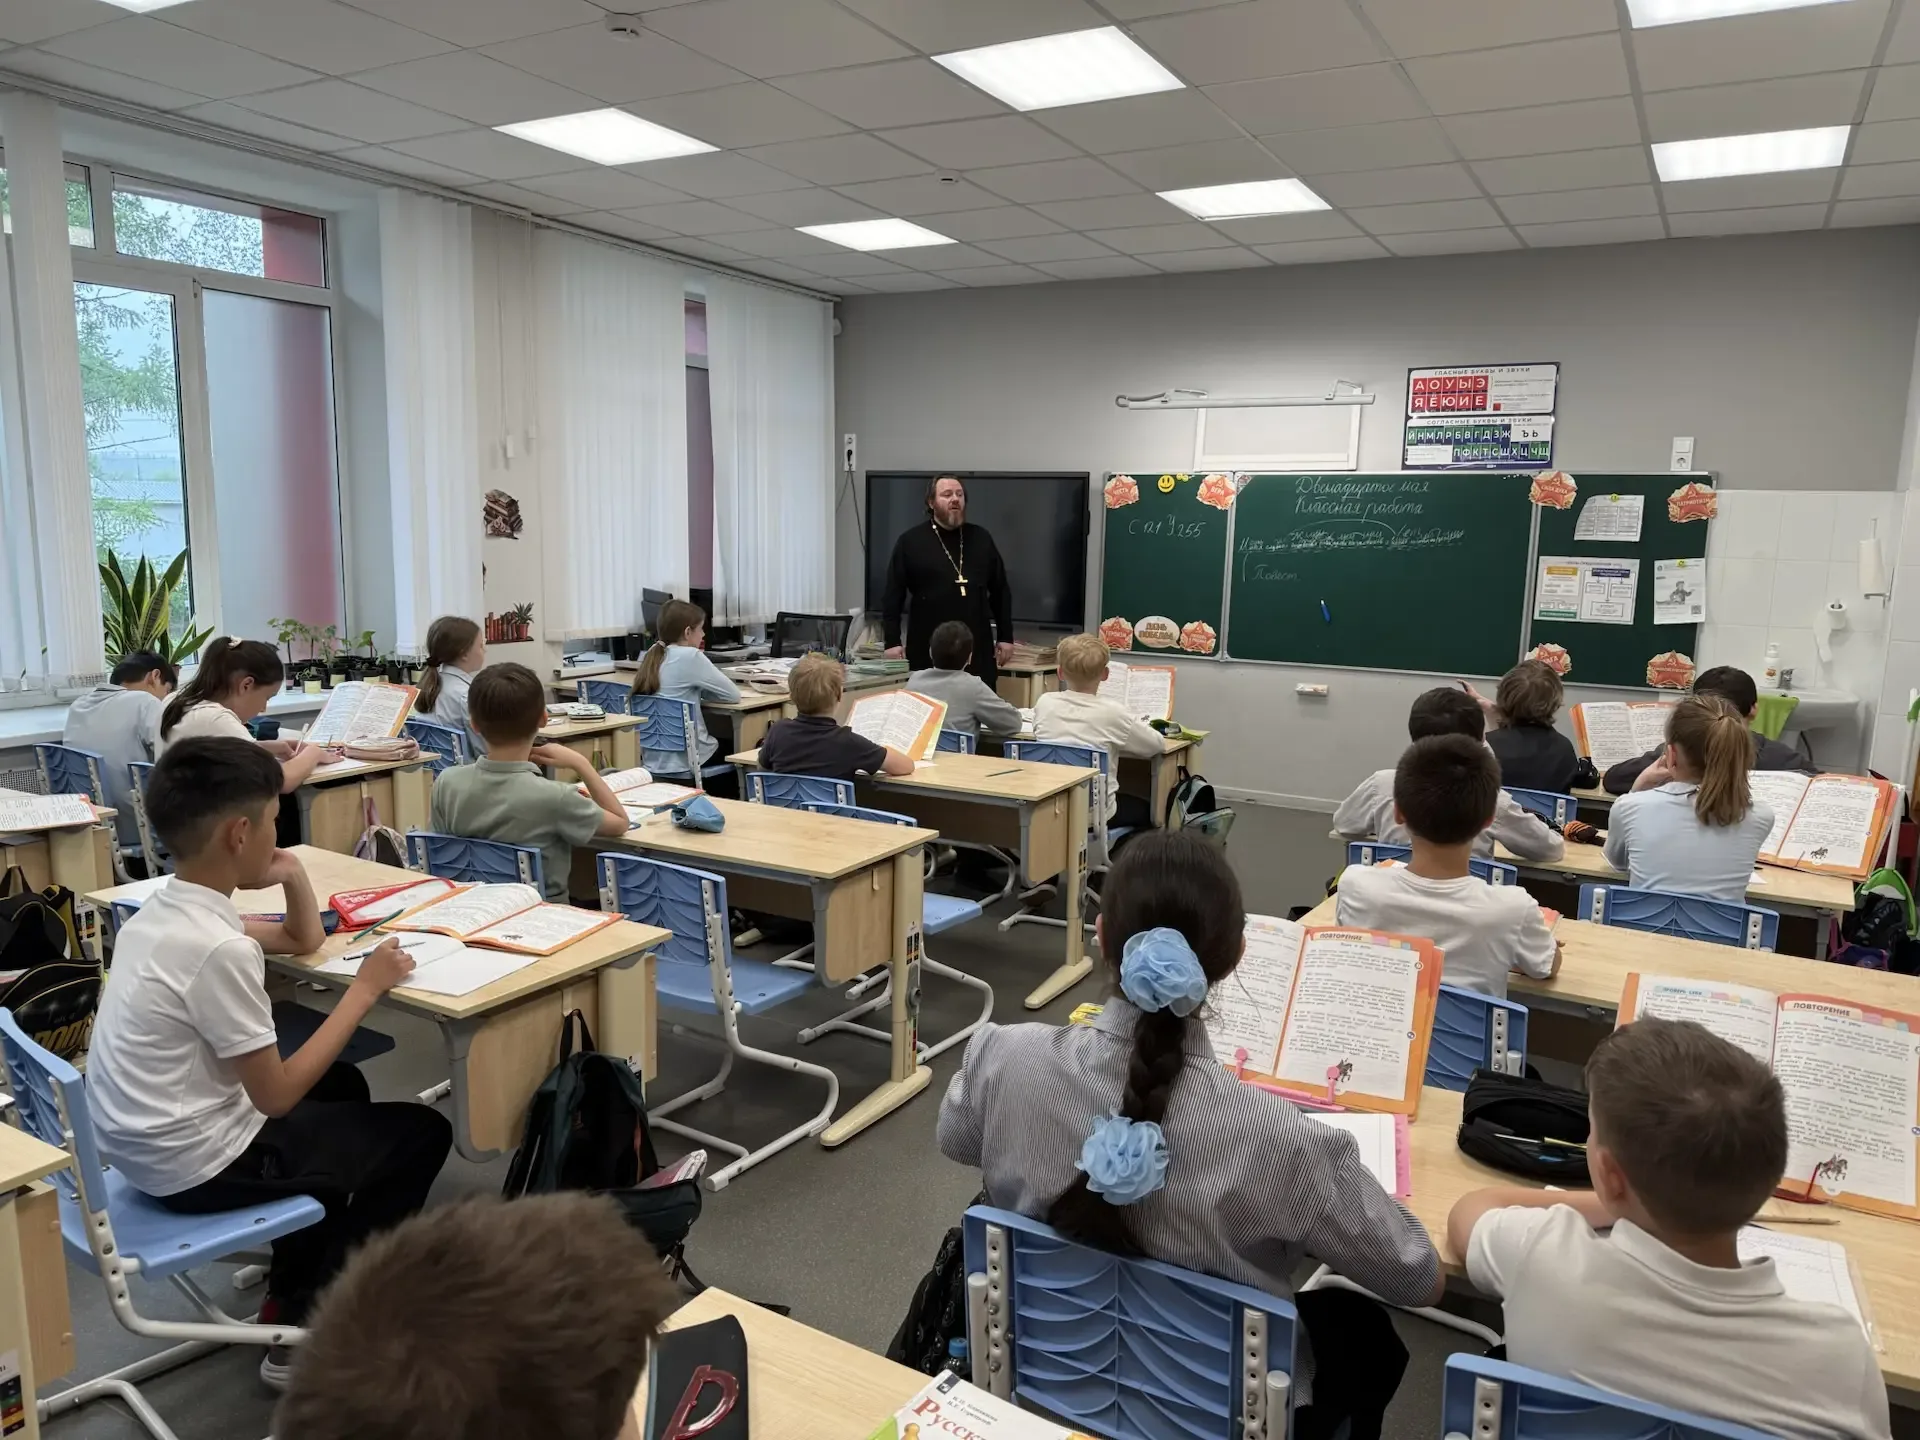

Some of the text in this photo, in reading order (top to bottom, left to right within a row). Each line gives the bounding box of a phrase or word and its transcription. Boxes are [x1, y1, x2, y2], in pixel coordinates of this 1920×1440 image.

[1414, 378, 1485, 390] А О У Ы Э
[1415, 394, 1483, 407] Я Ё Ю И Е
[1210, 487, 1225, 496] ВЕРА
[1400, 480, 1430, 492] мая
[1676, 498, 1711, 507] ПАТРИОТИЗМ
[1294, 498, 1424, 524] Классная работа
[1177, 522, 1206, 537] 255
[1146, 622, 1167, 631] ДЕНЬ
[1139, 631, 1174, 640] ПОБЕДЫ
[1794, 1002, 1850, 1016] ПОВТОРЕНИЕ
[912, 1396, 987, 1440] Русск
